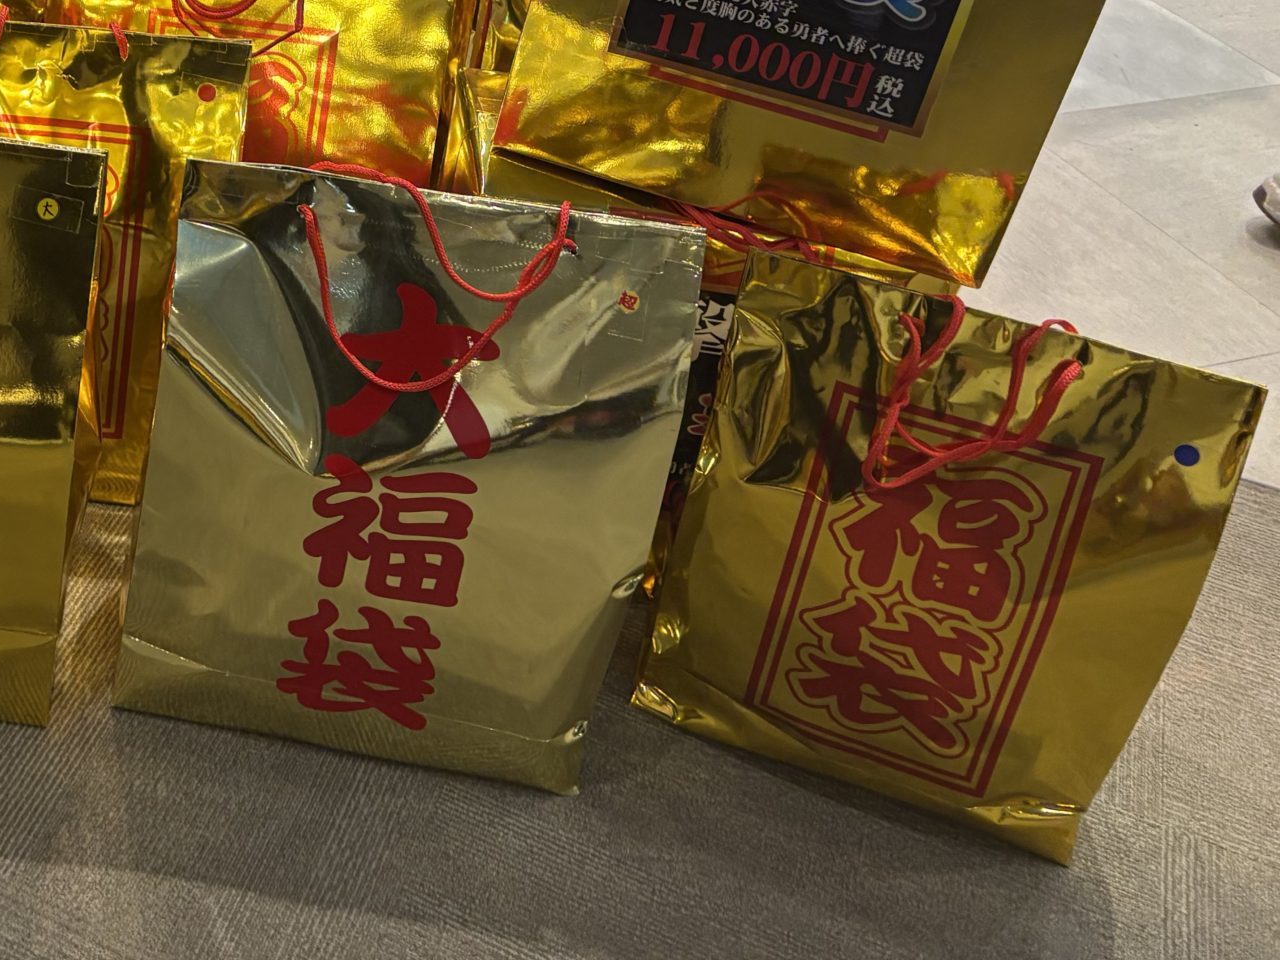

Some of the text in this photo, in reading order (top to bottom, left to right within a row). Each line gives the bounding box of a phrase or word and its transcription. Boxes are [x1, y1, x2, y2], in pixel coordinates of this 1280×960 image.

[652, 13, 904, 118] 11,000円 税込
[276, 283, 501, 731] 大福袋
[787, 448, 1046, 758] 福袋
